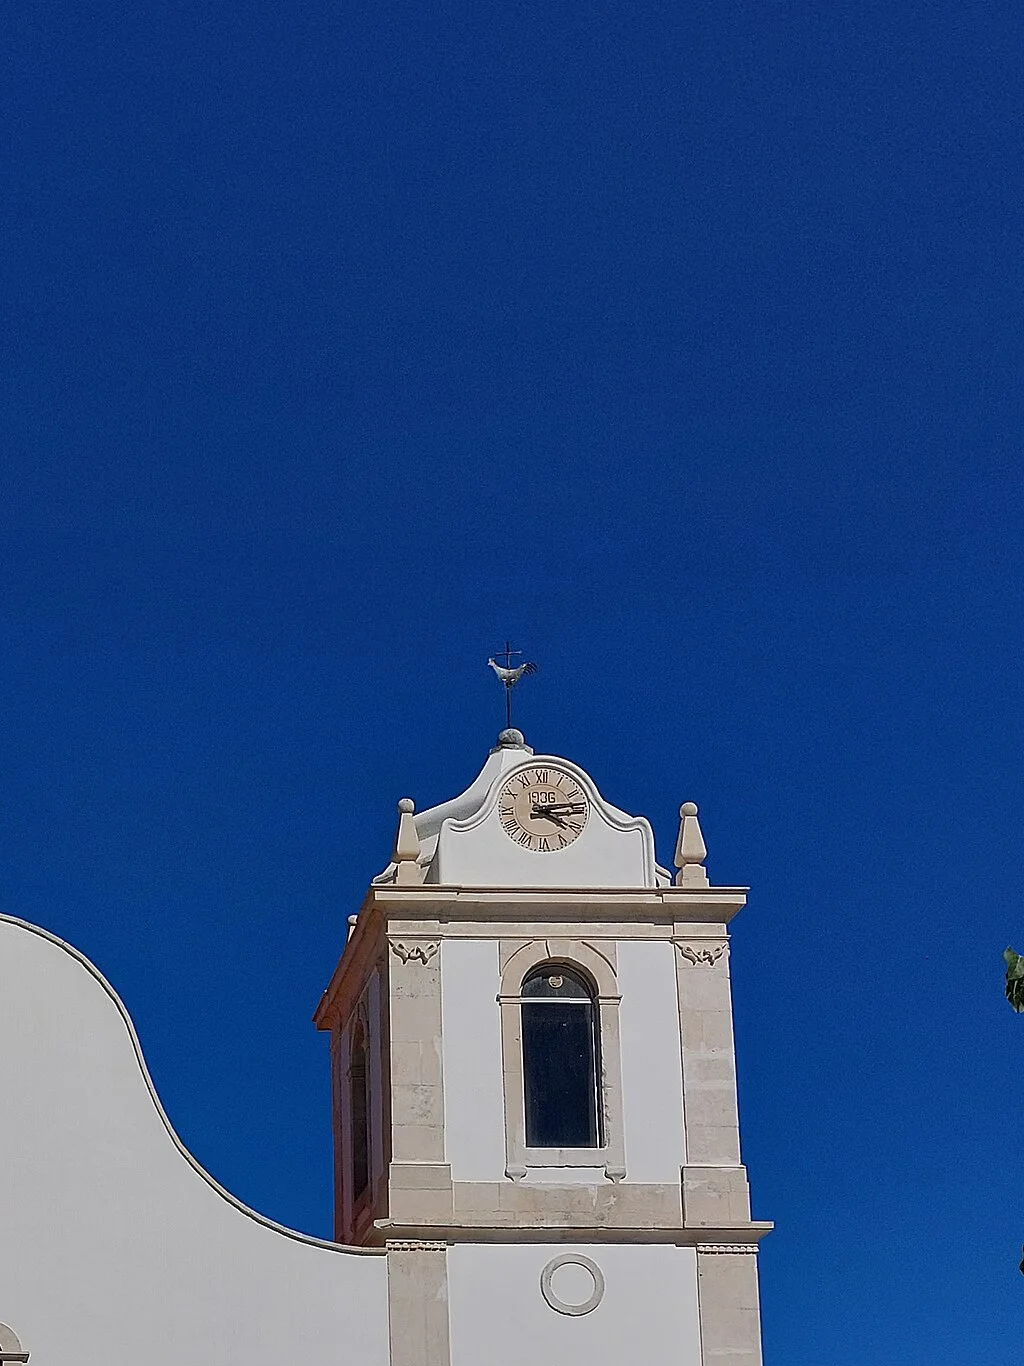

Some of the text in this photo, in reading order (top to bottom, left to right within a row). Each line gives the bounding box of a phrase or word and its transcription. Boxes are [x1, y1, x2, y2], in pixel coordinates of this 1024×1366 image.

[517, 775, 531, 789] XI
[535, 771, 548, 783] XII
[556, 776, 564, 787] I
[504, 788, 518, 800] X
[528, 791, 556, 803] 1936
[567, 789, 579, 799] II
[501, 806, 514, 815] IX
[504, 819, 520, 835] VIII
[568, 821, 581, 834] IV
[517, 832, 532, 847] VII
[539, 838, 550, 849] VI
[558, 834, 568, 846] V
